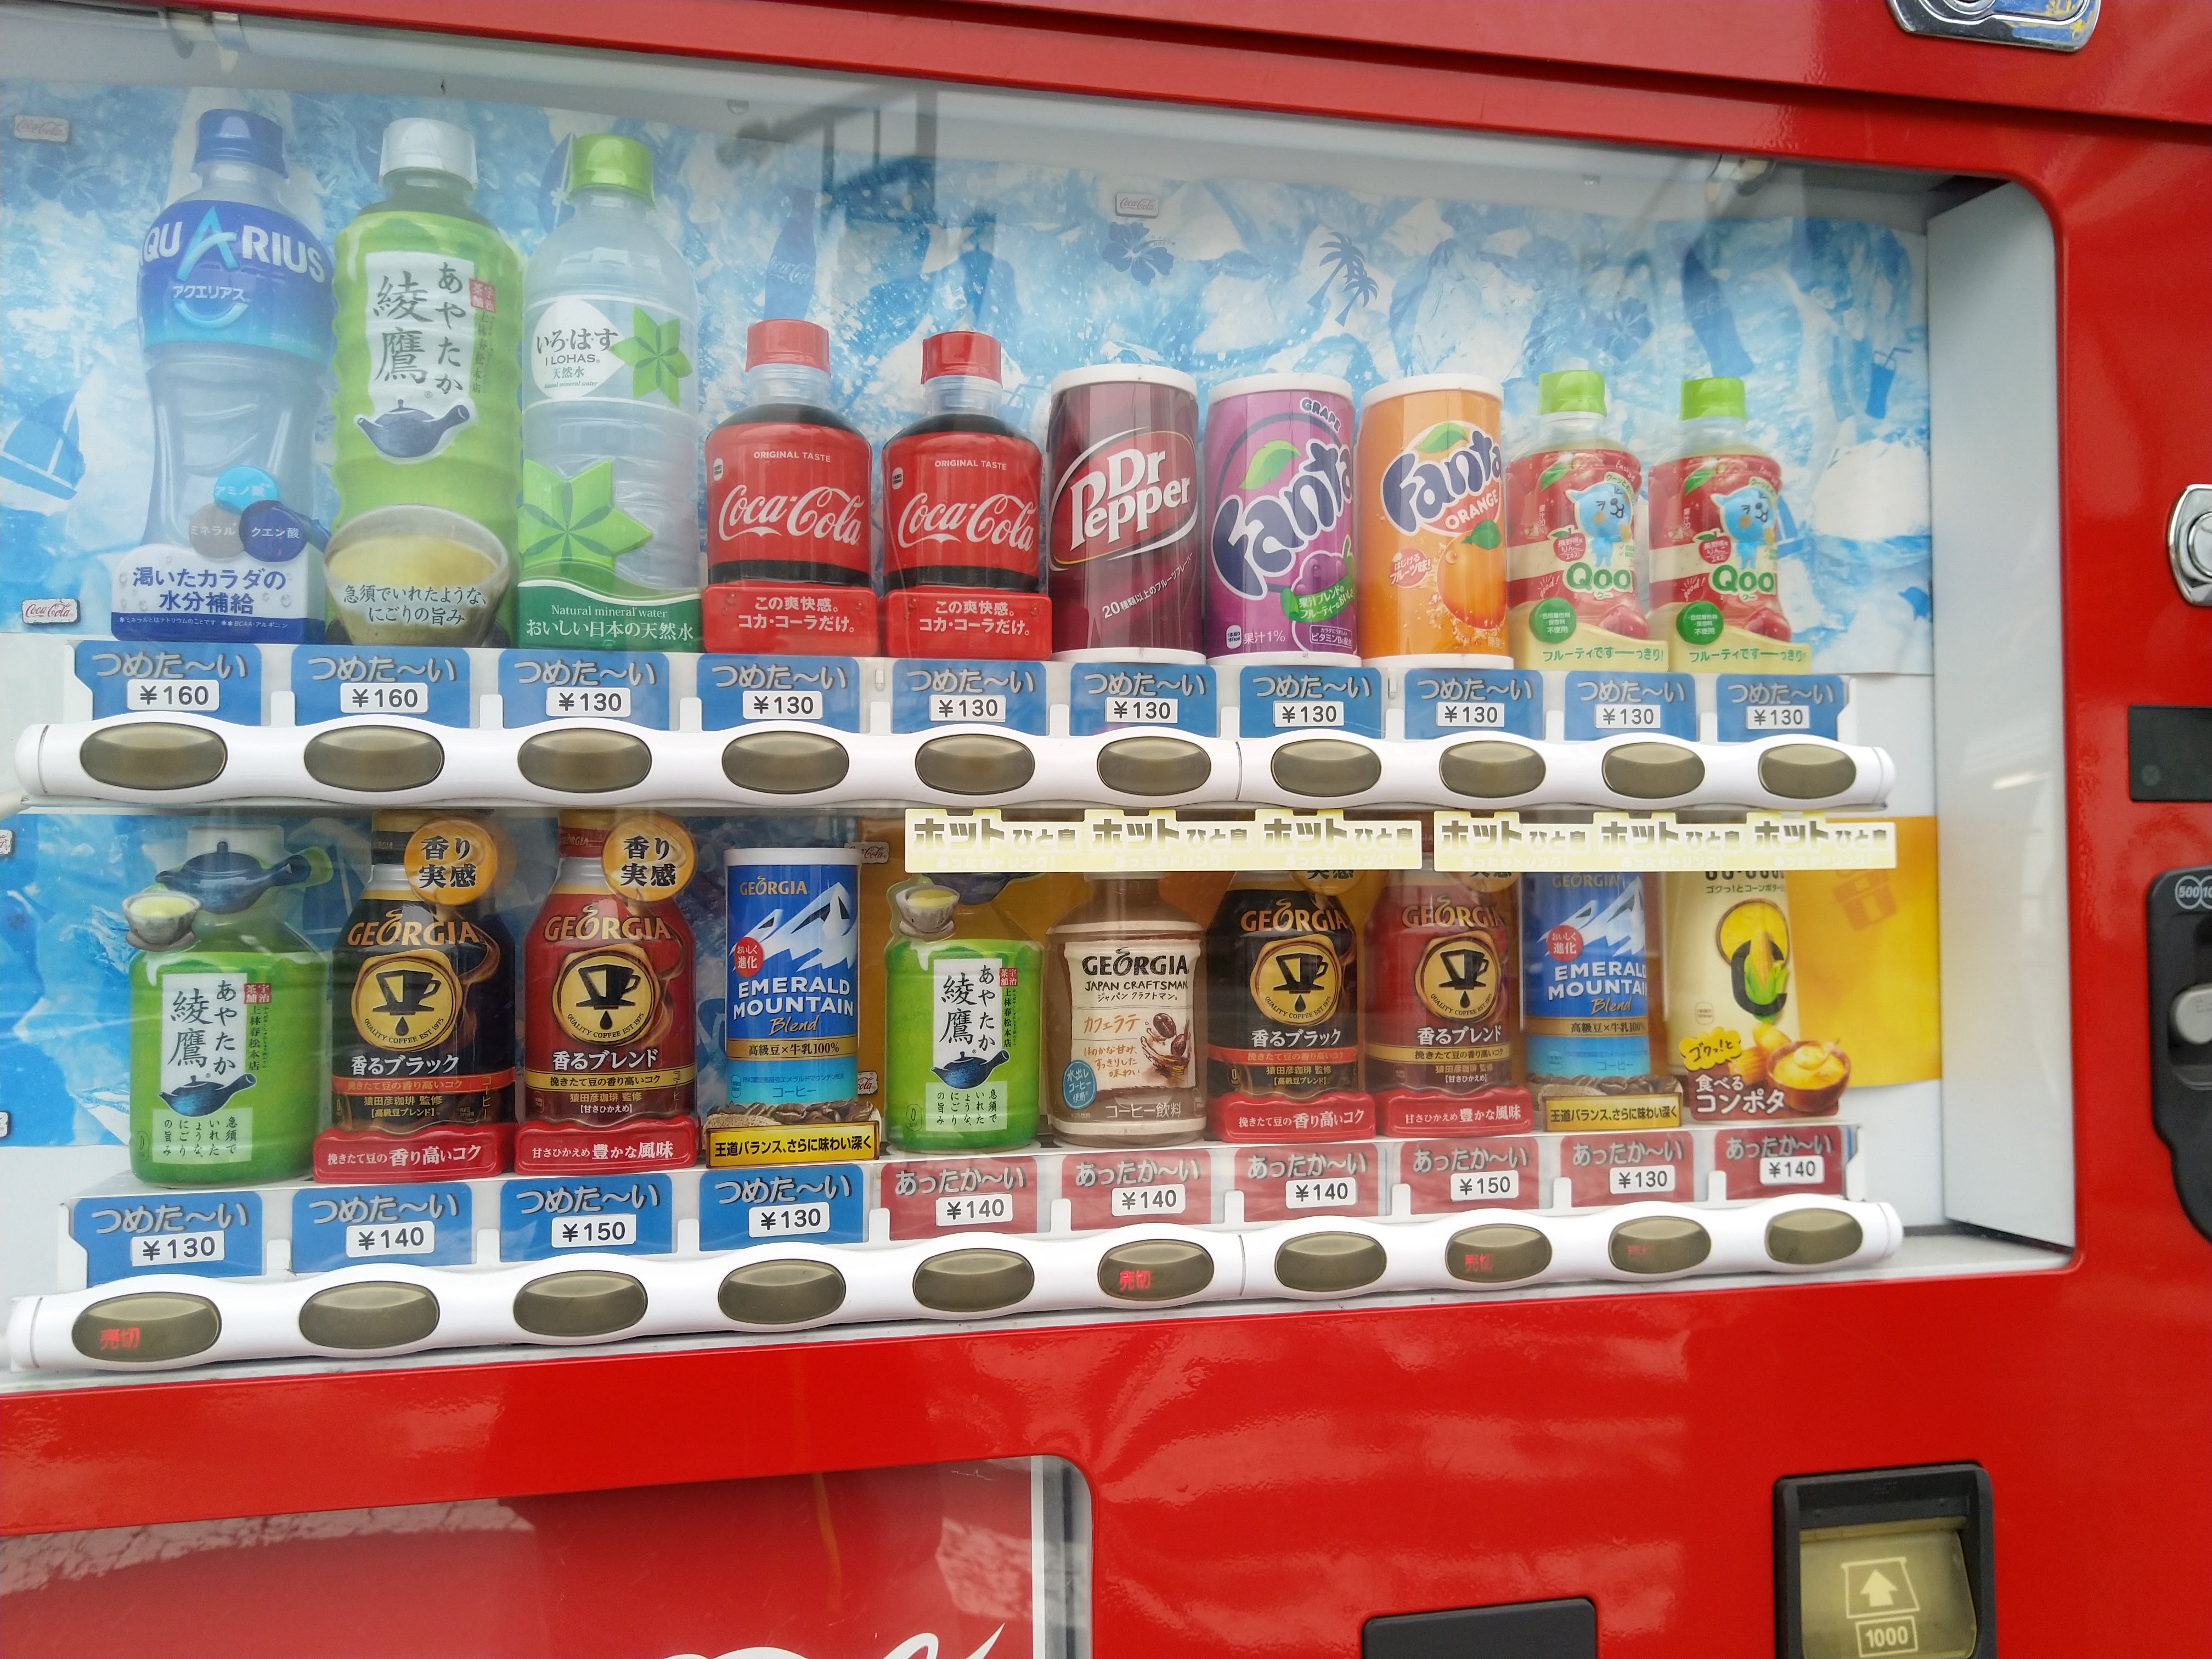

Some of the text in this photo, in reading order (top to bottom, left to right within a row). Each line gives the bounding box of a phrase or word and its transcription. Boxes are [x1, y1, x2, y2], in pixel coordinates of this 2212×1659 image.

[139, 206, 325, 283] QUARIUS
[173, 285, 246, 301] アクエリアス
[373, 270, 434, 385] 綾鷹
[435, 262, 466, 395] あやたか
[552, 366, 585, 380] 天然水
[1300, 398, 1341, 433] GRAPE
[754, 451, 831, 463] ORIGINAL TASTE
[934, 460, 1007, 471] ORIGINAL TASTE
[1107, 448, 1166, 503] Dr
[1381, 430, 1502, 535] Fanta
[719, 484, 866, 546] Coca-Cola
[1070, 471, 1191, 551] Pepper
[1212, 439, 1354, 600] Fanta
[1444, 489, 1498, 530] ORANGE
[898, 493, 1038, 552] Coca-Cola
[251, 527, 300, 540] クエン酸
[132, 567, 286, 591] 渇いたカラダの
[1566, 562, 1632, 591] Qoo
[1712, 565, 1775, 592] Qoo
[159, 591, 255, 615] 水分補給
[343, 584, 487, 606] 急須でいれたような、
[754, 597, 839, 612] この爽快感。
[368, 605, 465, 626] にごりの旨み
[551, 604, 668, 619] Natural mineral water
[935, 600, 1015, 616] この爽快感。
[526, 620, 694, 641] おいしい日本の天然水
[1243, 630, 1286, 645] 果汁1%
[140, 685, 210, 706] ¥160
[352, 687, 419, 708] ¥160
[557, 692, 622, 712] ¥130
[754, 696, 814, 715] ¥130
[938, 699, 998, 718] ¥130
[1114, 701, 1171, 720] ¥130
[1282, 704, 1338, 724] ¥130
[1444, 706, 1498, 724] ¥130
[1602, 708, 1655, 726] ¥130
[1753, 709, 1803, 726] ¥130
[420, 836, 471, 861] 香り
[623, 834, 670, 861] 香り
[419, 862, 477, 889] 実感
[620, 863, 676, 887] 実感
[740, 876, 809, 896] GEORGIA
[2178, 885, 2200, 899] 500
[1240, 898, 1348, 932] GEORGIA
[1402, 896, 1506, 928] GEORGIA
[348, 909, 479, 946] GEORGIA
[544, 904, 672, 942] GEORGIA
[1551, 932, 1577, 941] おいしく
[736, 944, 758, 955] おいしく
[1553, 943, 1577, 955] 進化
[737, 956, 758, 970] 進化
[1082, 947, 1189, 977] GEORGIA
[1555, 962, 1646, 981] EMERALD
[738, 976, 851, 999] EMERALD
[1085, 981, 1119, 992] JAPAN
[1098, 992, 1128, 1002] ジャパン
[1548, 980, 1647, 1001] MOUNTAI
[733, 997, 854, 1021] MOUNTAIN
[939, 972, 977, 1045] 綾鷹
[978, 964, 996, 1052] あやたか
[1590, 996, 1632, 1015] Blend
[168, 989, 214, 1068] 綾鷹
[214, 980, 237, 1076] あやたか
[567, 1013, 592, 1035] QUALITY
[593, 1030, 621, 1039] COFFEE
[622, 1024, 635, 1034] EST
[769, 1014, 820, 1036] Blend
[1003, 988, 1012, 1048] 上林春松本店
[1084, 1014, 1140, 1034] カフェラテ
[249, 1006, 261, 1070] 上林春松本店
[364, 1018, 388, 1041] QUALITY
[419, 1029, 432, 1040] EST
[1251, 1029, 1341, 1048] 香るブラック
[1417, 1025, 1502, 1045] 香るブレンド
[748, 1042, 839, 1057] 高級豆×牛乳100%
[1414, 1048, 1504, 1059] 挽きたて豆の香り高いコク
[352, 1054, 460, 1076] 香るブラック
[552, 1051, 658, 1072] 香るブレンド
[1094, 1058, 1138, 1070] すっきりした
[1597, 1060, 1633, 1070] コーヒー
[550, 1074, 661, 1088] 挽きたて豆の香り高いコク
[1067, 1069, 1089, 1082] 水出し
[1109, 1068, 1140, 1079] 味わい
[1695, 1074, 1744, 1093] 食べる
[622, 1091, 642, 1102] 監修
[772, 1085, 816, 1098] コーヒー
[1069, 1080, 1092, 1093] コーヒー
[419, 1095, 443, 1106] 監修
[936, 1091, 945, 1125] の旨み
[950, 1091, 959, 1126] にごり
[976, 1090, 985, 1125] いれた
[989, 1088, 997, 1123] 急須で
[1105, 1102, 1182, 1119] コーヒー飲料
[1697, 1089, 1785, 1114] コンポタ
[1238, 1109, 1364, 1129] 挽きたて豆の香り高いコク
[1404, 1104, 1522, 1124] 甘さひかえめ豊かな風味
[1550, 1106, 1677, 1122] 王道バランス、さらに味わい深く
[328, 1144, 482, 1167] 挽きたて豆の香り高いコク
[532, 1141, 674, 1161] 甘さひかえめ豊かな風味
[714, 1135, 872, 1158] 王道バランス、さらに味わい深く
[1618, 1170, 1668, 1189] ¥130
[1769, 1160, 1815, 1178] ¥140
[1295, 1182, 1348, 1203] ¥140
[1460, 1176, 1510, 1195] ¥150
[947, 1199, 1005, 1220] ¥140
[1122, 1189, 1177, 1210] ¥140
[761, 1209, 821, 1231] ¥130
[358, 1227, 424, 1251] ¥140
[562, 1221, 625, 1243] ¥150
[142, 1237, 215, 1260] ¥130
[1119, 1269, 1151, 1291] 売切
[99, 1328, 140, 1351] 売切
[1865, 1626, 1909, 1648] 1000
